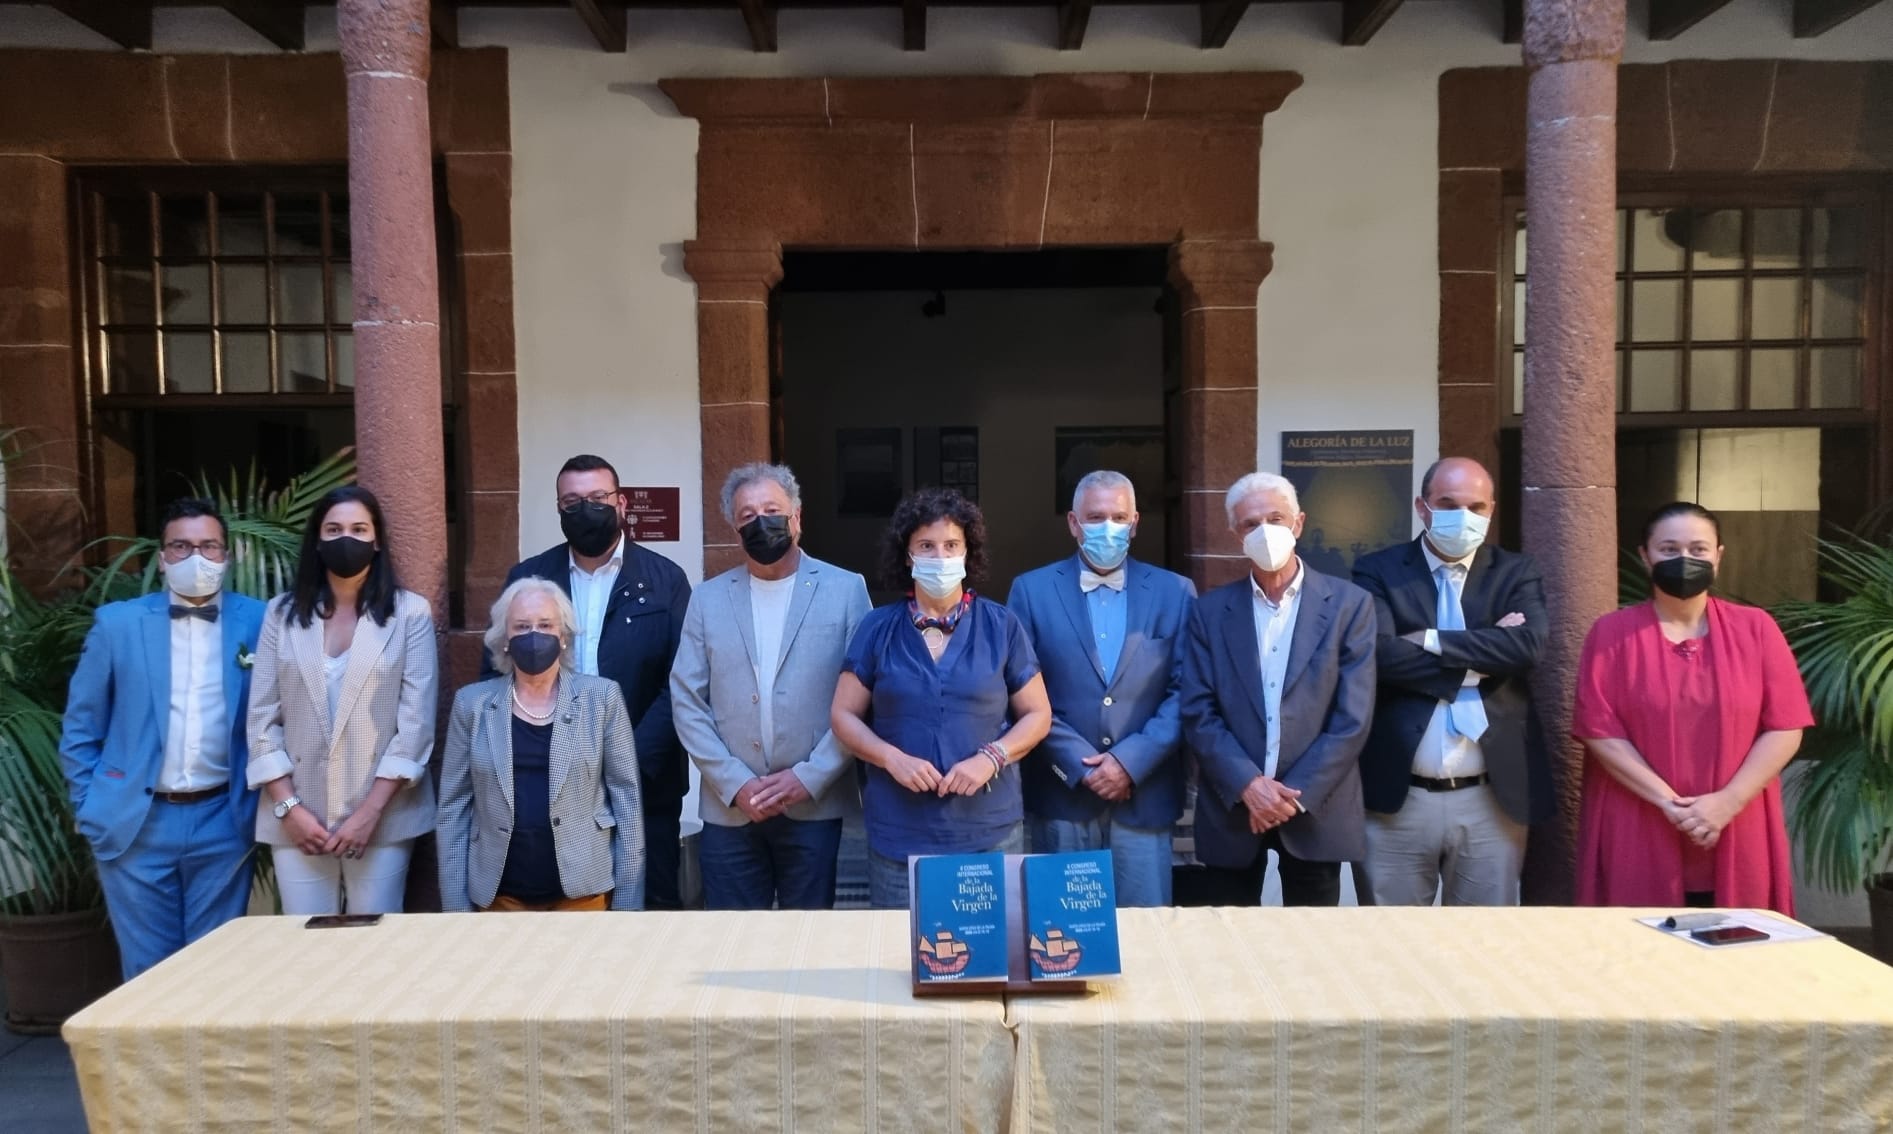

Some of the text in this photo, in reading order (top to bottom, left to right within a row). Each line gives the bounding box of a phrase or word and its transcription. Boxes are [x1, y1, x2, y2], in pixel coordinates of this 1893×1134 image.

[1288, 435, 1410, 448] ALEGORÍA DE LA LUZ
[959, 882, 993, 896] Bajada
[1066, 879, 1102, 894] Bajada
[977, 892, 998, 901] de la
[1086, 890, 1107, 899] de la
[952, 899, 992, 914] Virgen
[1060, 897, 1101, 912] Virgen
